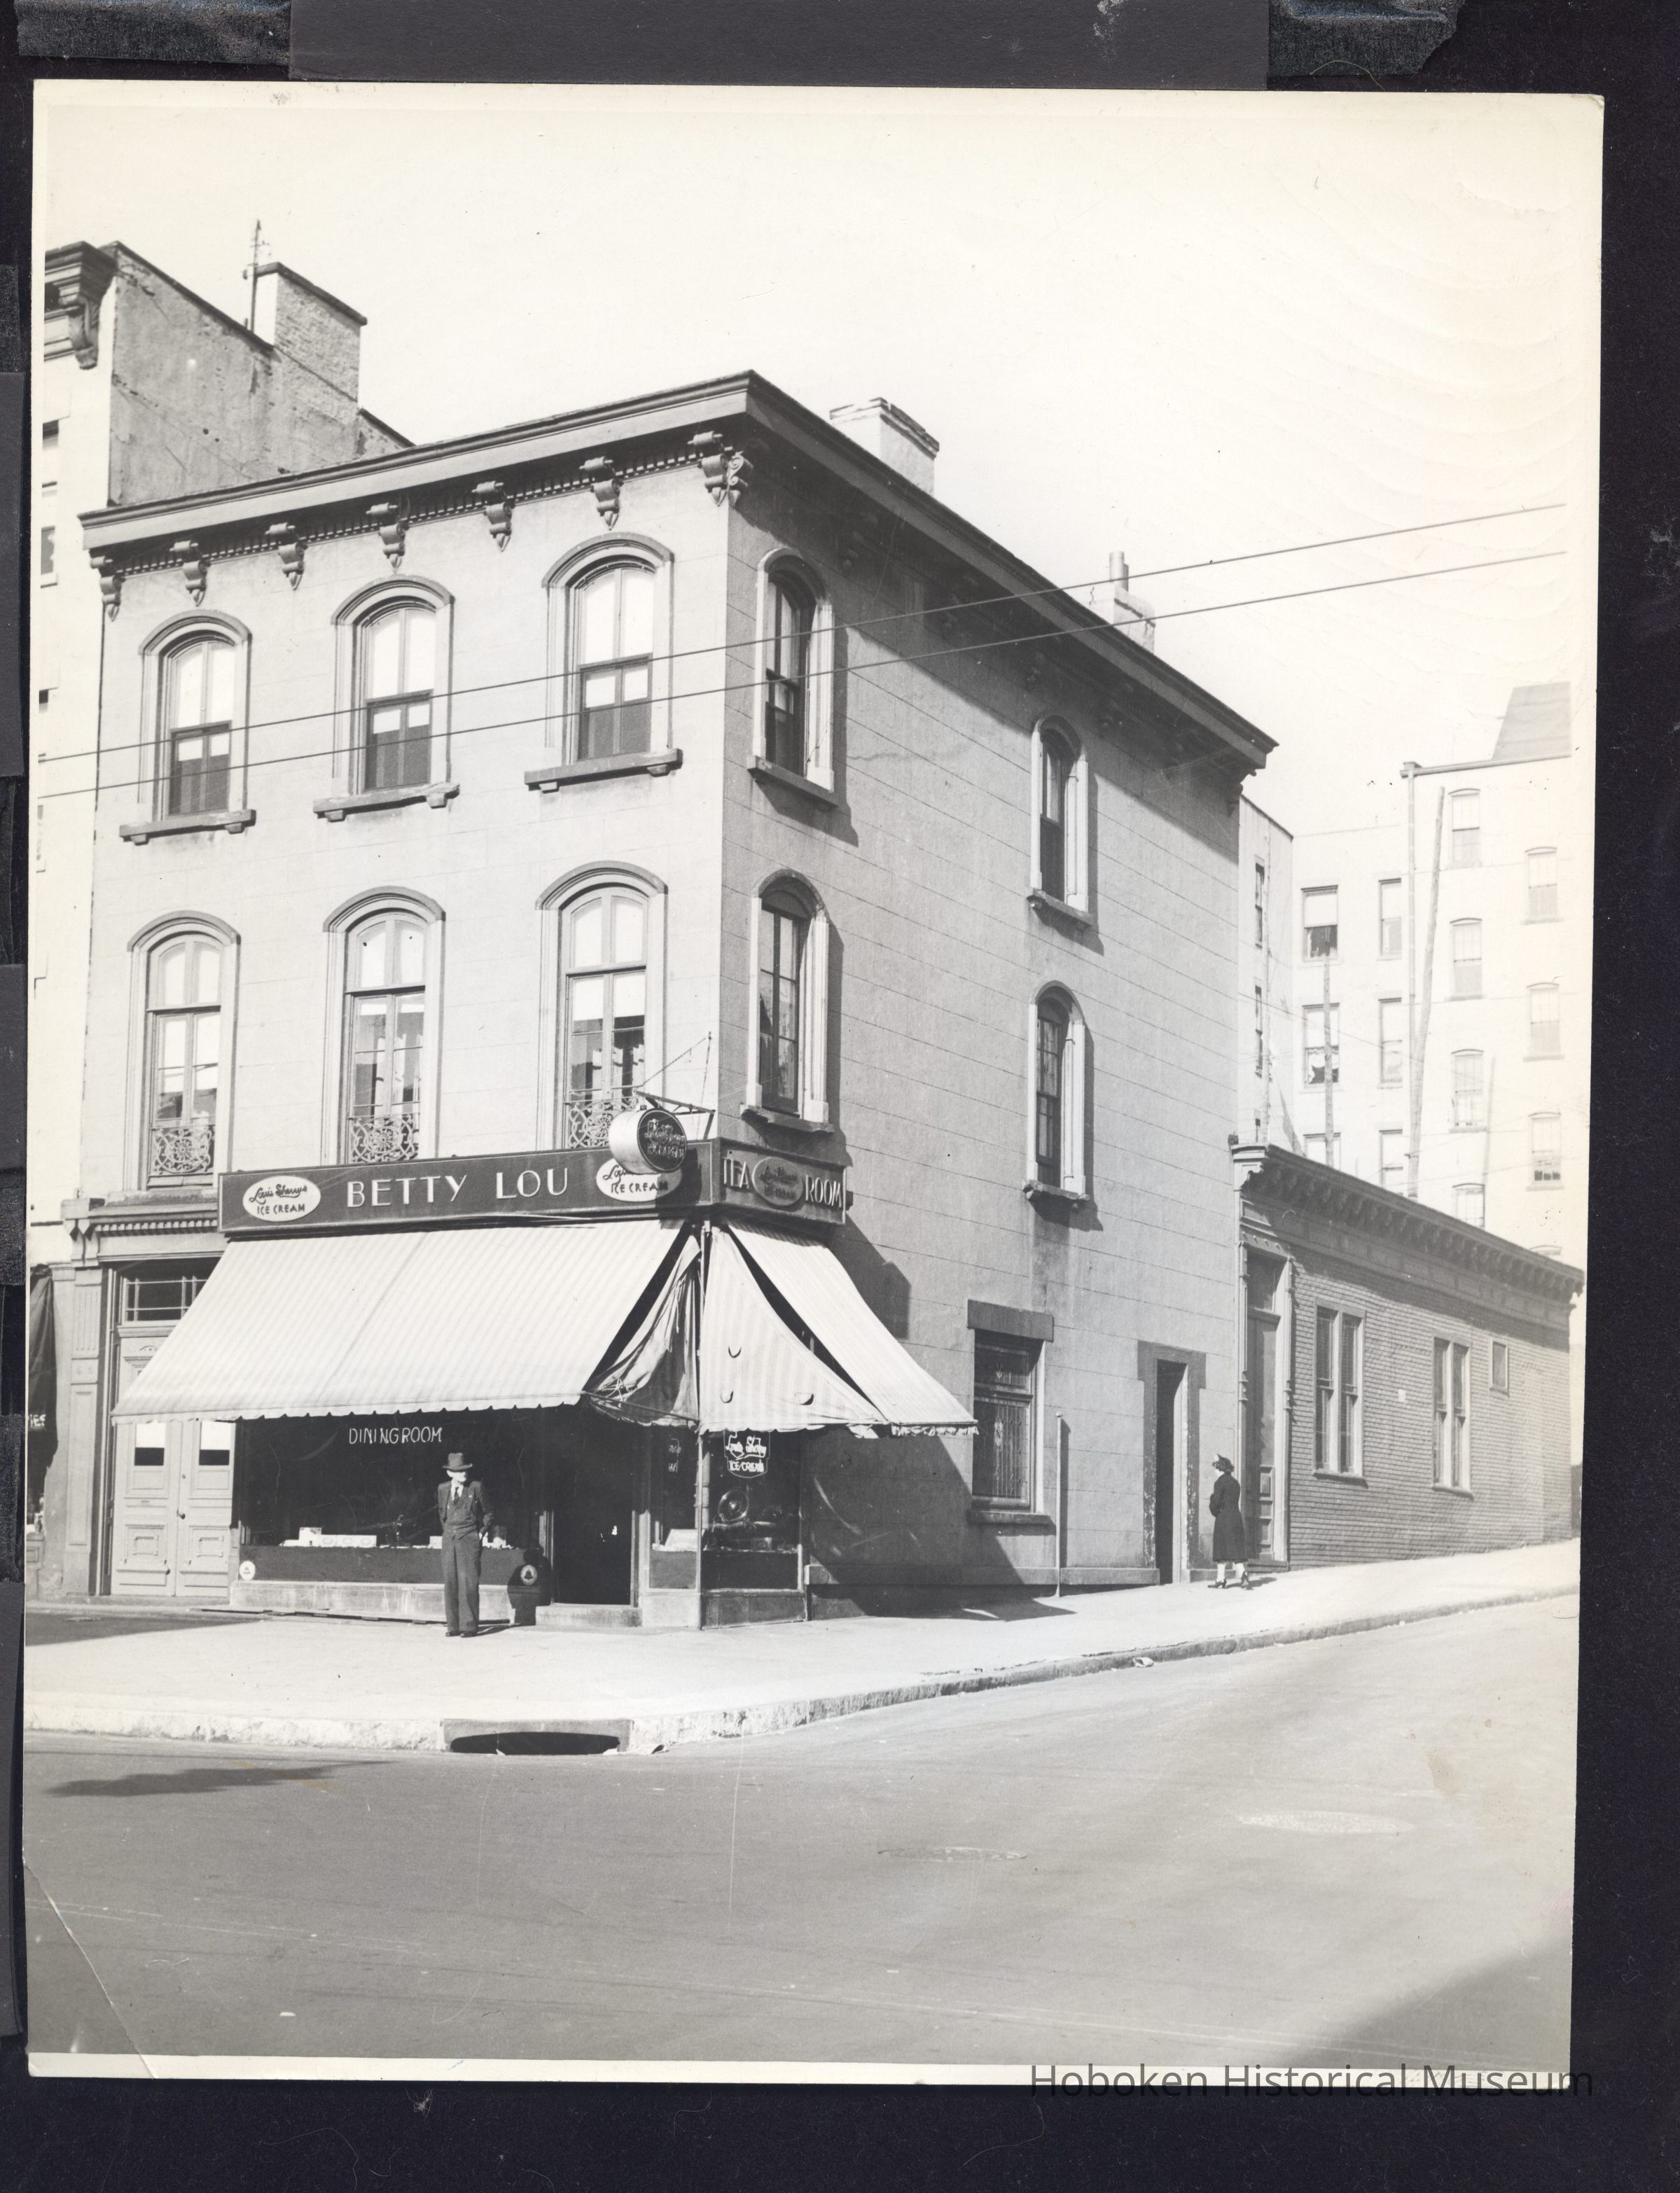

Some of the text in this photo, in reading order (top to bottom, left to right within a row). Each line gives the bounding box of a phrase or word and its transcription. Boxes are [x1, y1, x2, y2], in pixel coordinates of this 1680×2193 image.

[347, 1167, 568, 1208] BETTY LOU
[611, 1181, 669, 1195] ICE CREAM
[723, 1157, 749, 1190] TEA
[805, 1174, 842, 1209] ROOM
[249, 1187, 275, 1205] Louis
[257, 1204, 306, 1216] ICE CREAM
[28, 1414, 46, 1428] IES
